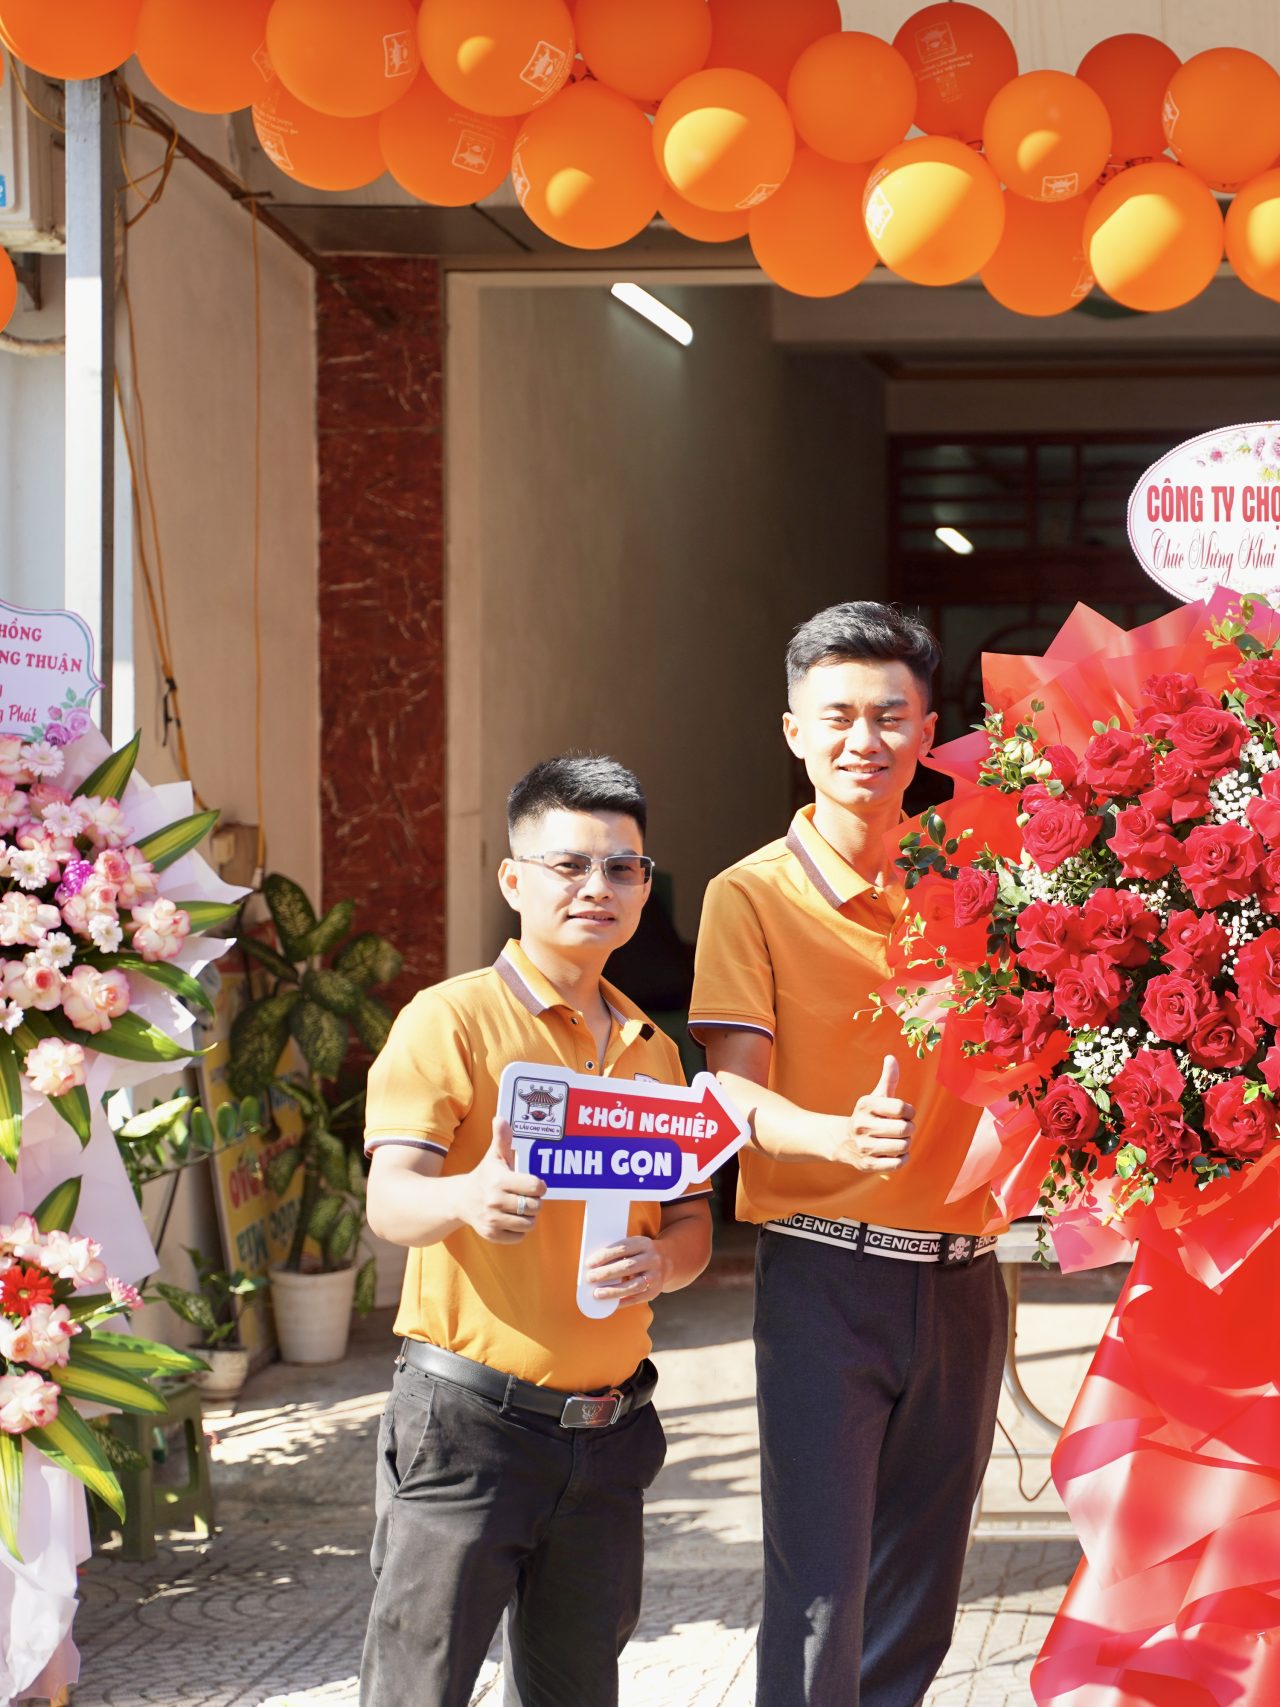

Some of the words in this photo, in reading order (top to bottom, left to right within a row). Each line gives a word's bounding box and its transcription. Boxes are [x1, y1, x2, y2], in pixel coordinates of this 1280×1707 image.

[1147, 478, 1203, 522] CÔNG
[1211, 486, 1235, 522] TY
[1152, 528, 1184, 570] Chúc
[1188, 530, 1233, 584] Mừng
[1238, 530, 1277, 570] Khai
[26, 653, 82, 675] THUẬN
[8, 703, 38, 724] Phát
[577, 1100, 634, 1131] KHỞI
[639, 1110, 719, 1144] NGHIỆP
[537, 1147, 603, 1176] TINH
[610, 1149, 672, 1183] GỌN
